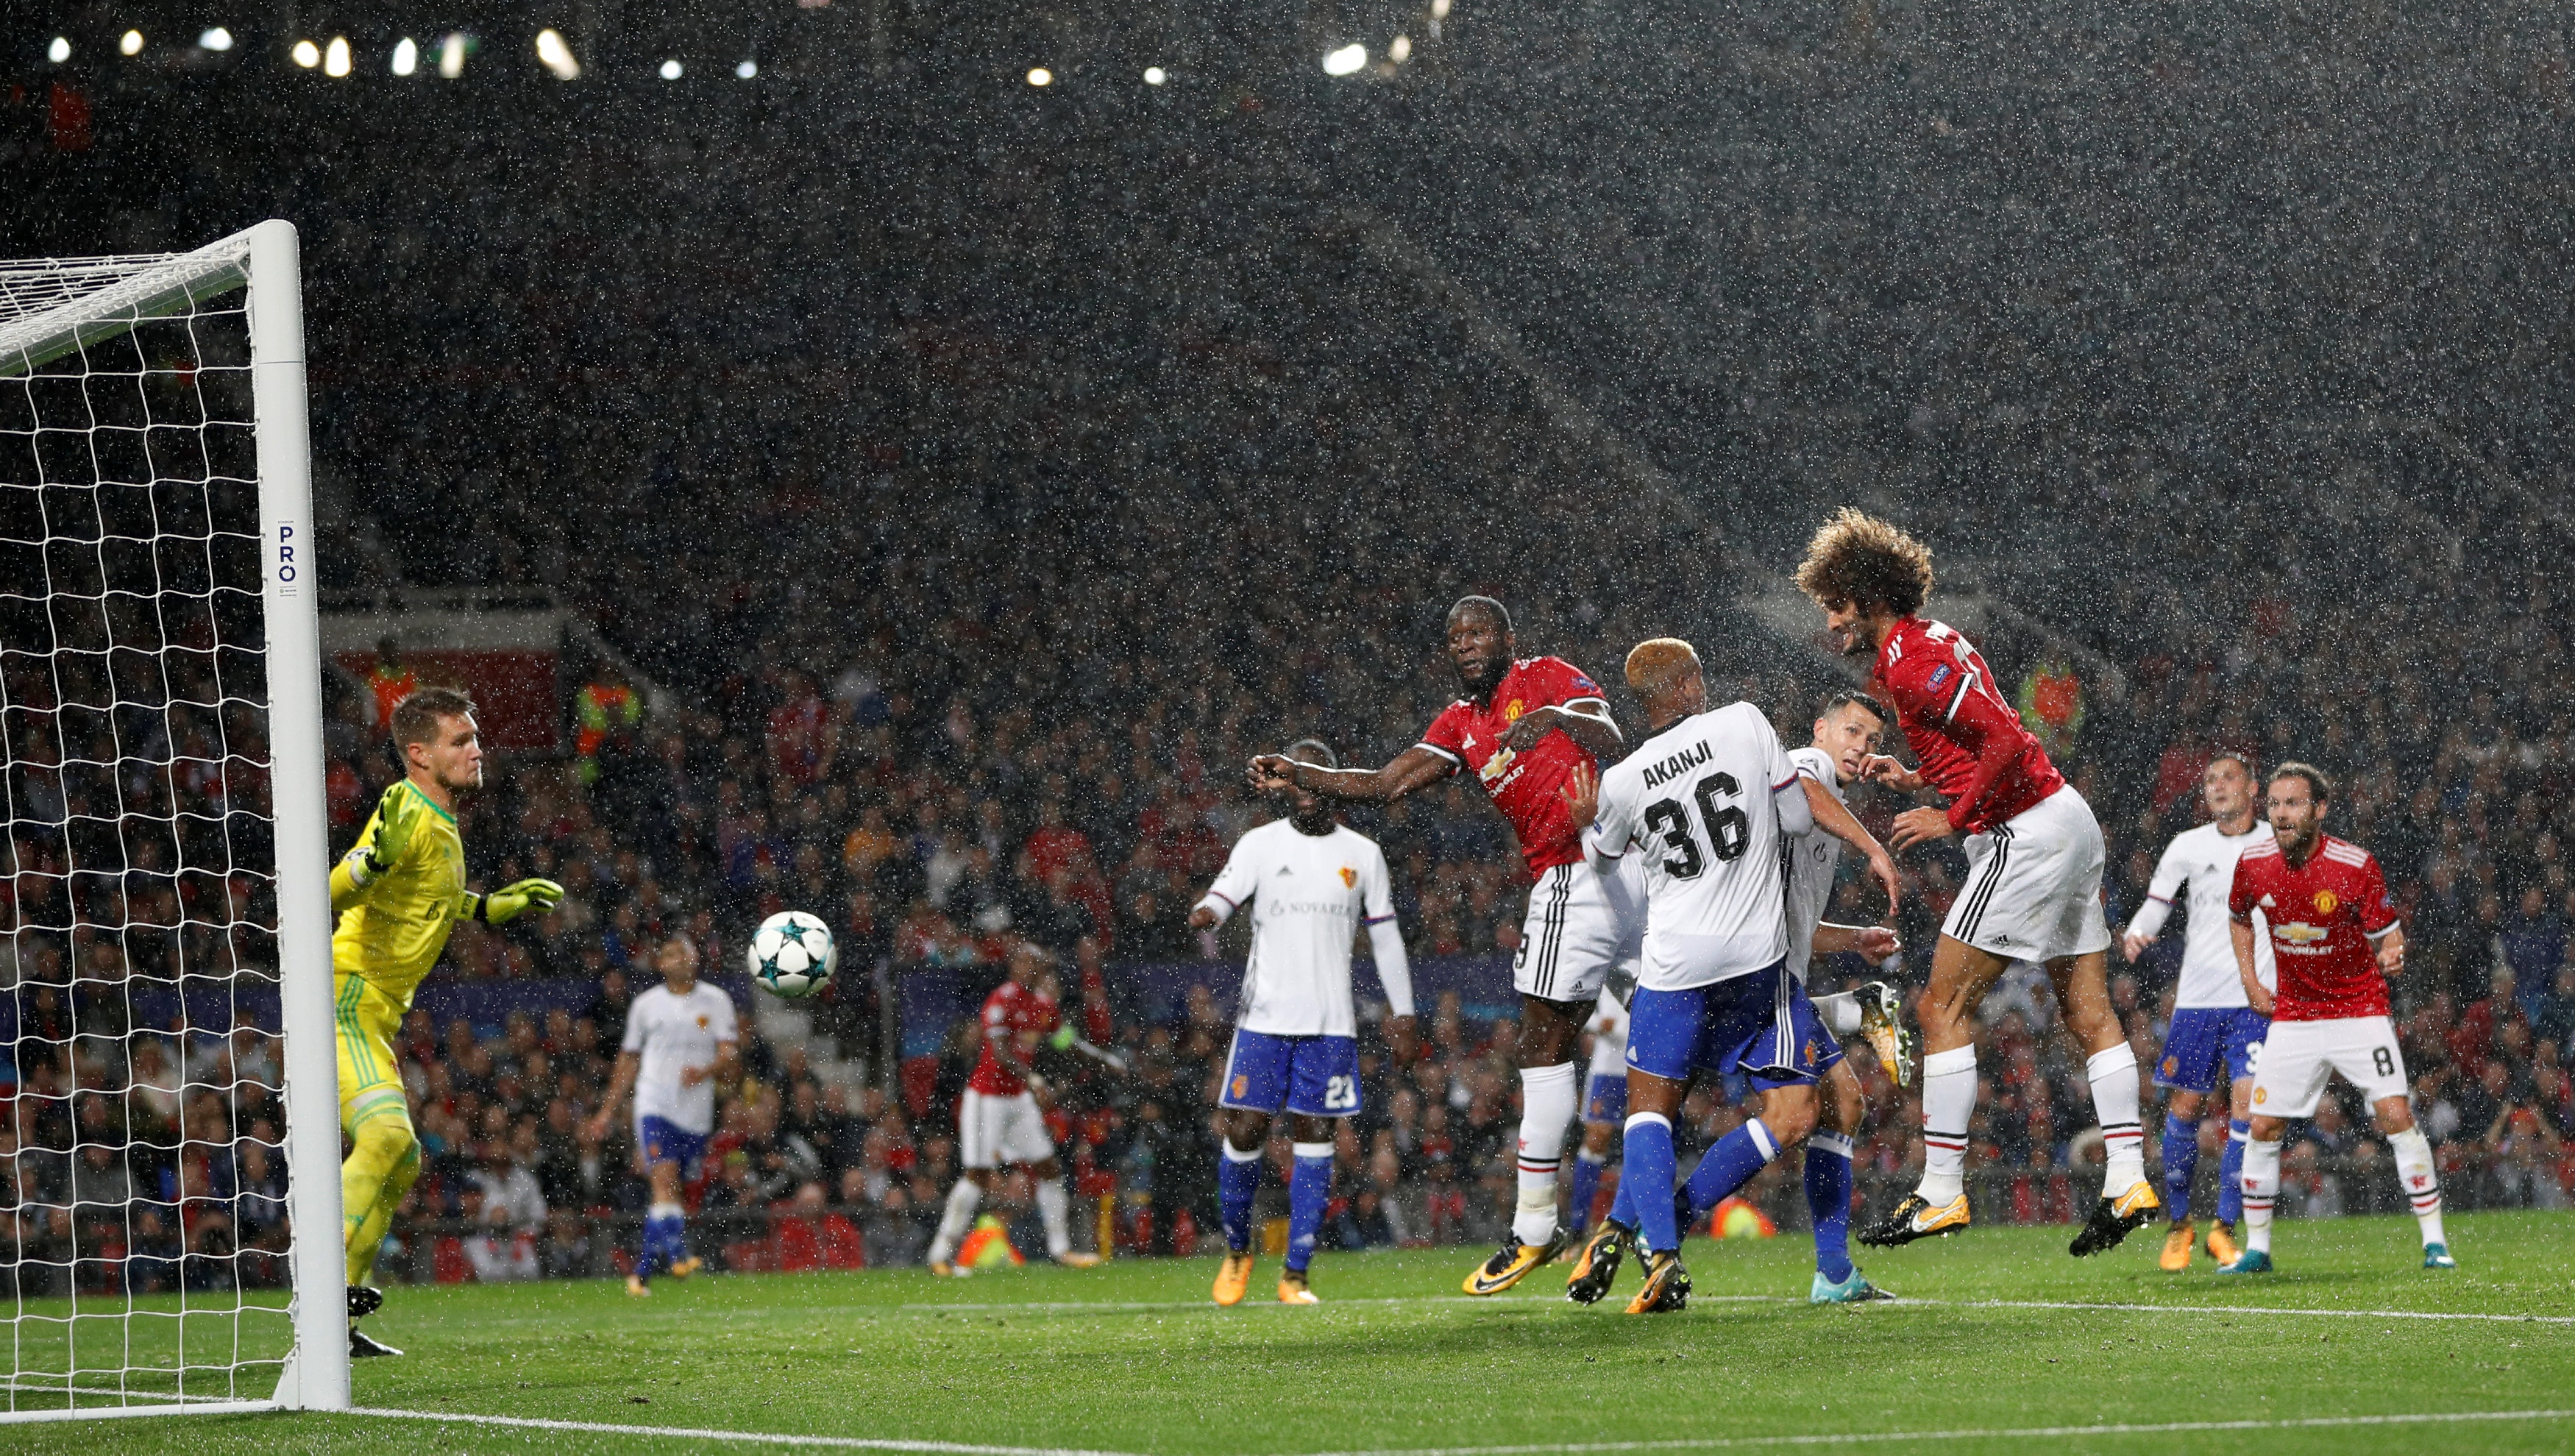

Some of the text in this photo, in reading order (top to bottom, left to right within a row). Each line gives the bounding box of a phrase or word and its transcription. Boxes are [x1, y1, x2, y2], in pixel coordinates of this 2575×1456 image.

[279, 526, 296, 582] PRO
[1642, 739, 1713, 790] AKANJI
[1644, 771, 1750, 881] 36
[2373, 1045, 2395, 1077] 8
[1325, 1073, 1357, 1109] 23
